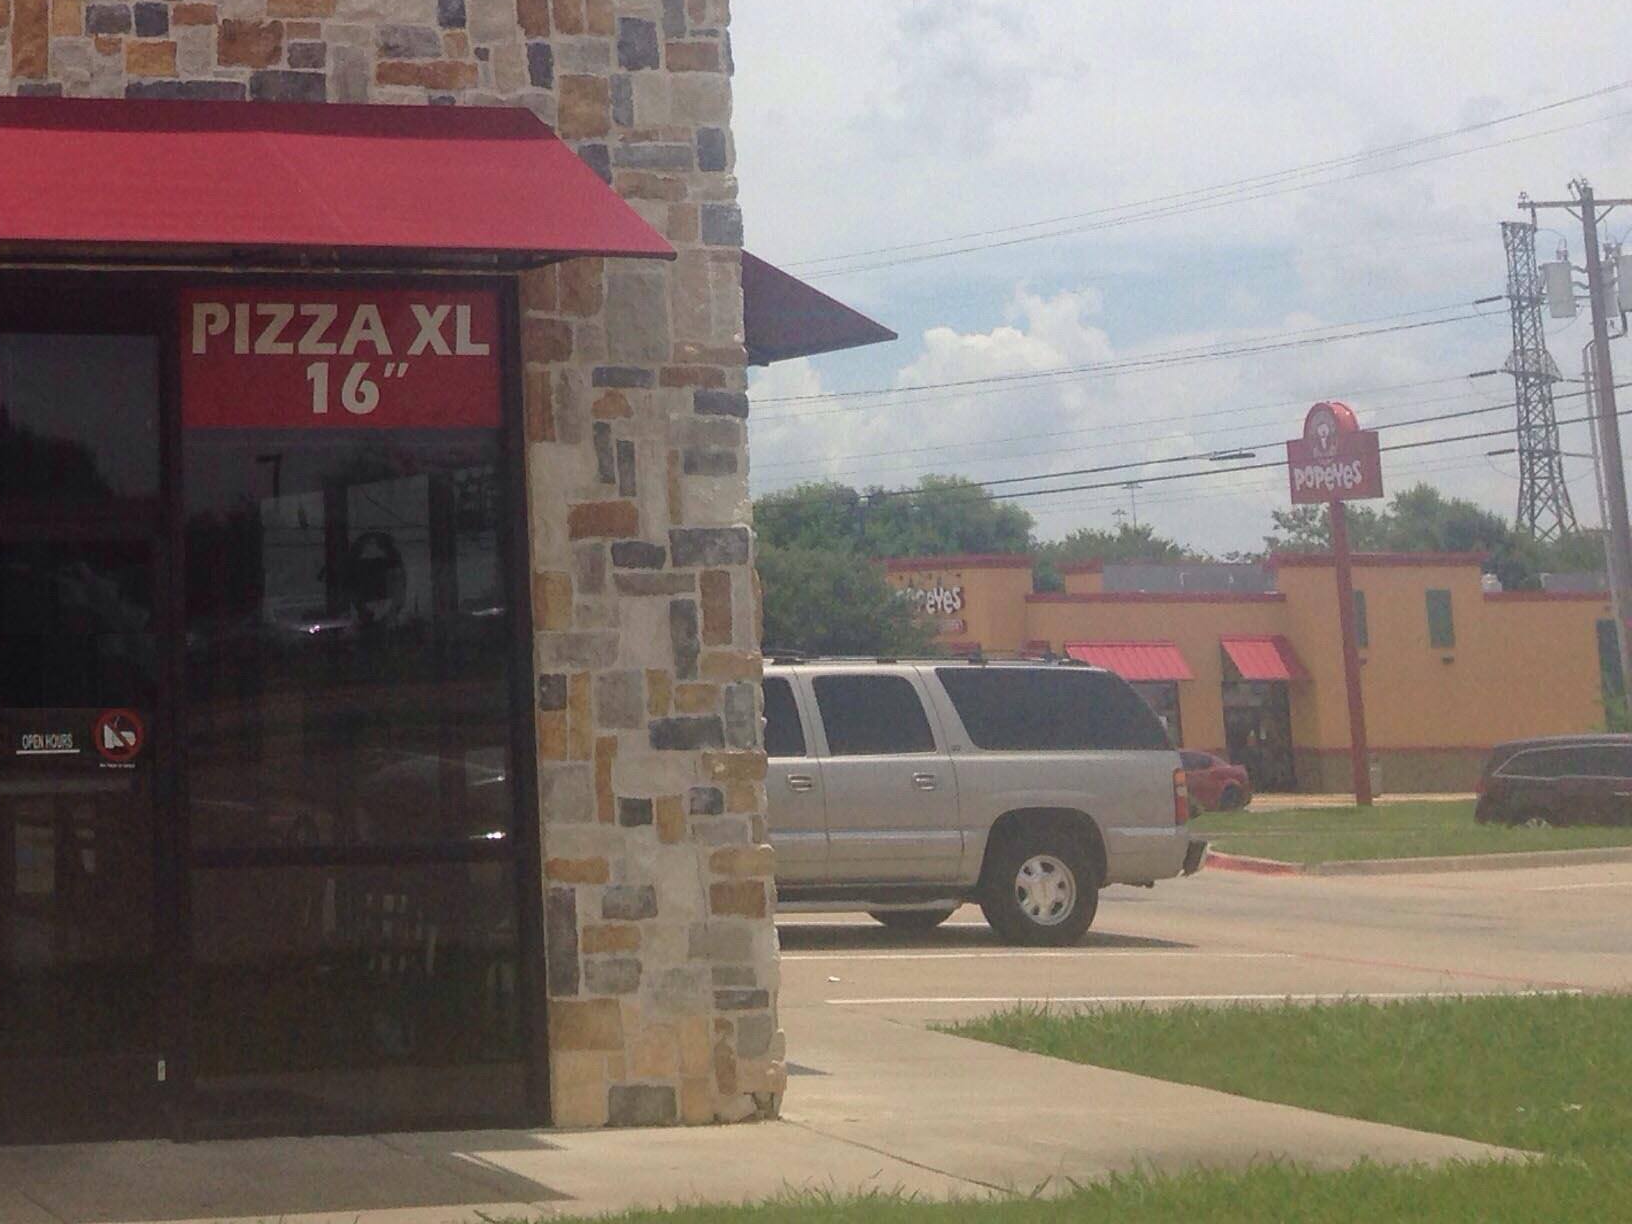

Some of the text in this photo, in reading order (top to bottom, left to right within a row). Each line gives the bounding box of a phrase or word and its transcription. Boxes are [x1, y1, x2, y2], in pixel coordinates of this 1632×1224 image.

[191, 302, 490, 356] PIZZA XL
[21, 733, 73, 749] OPEN HOURS
